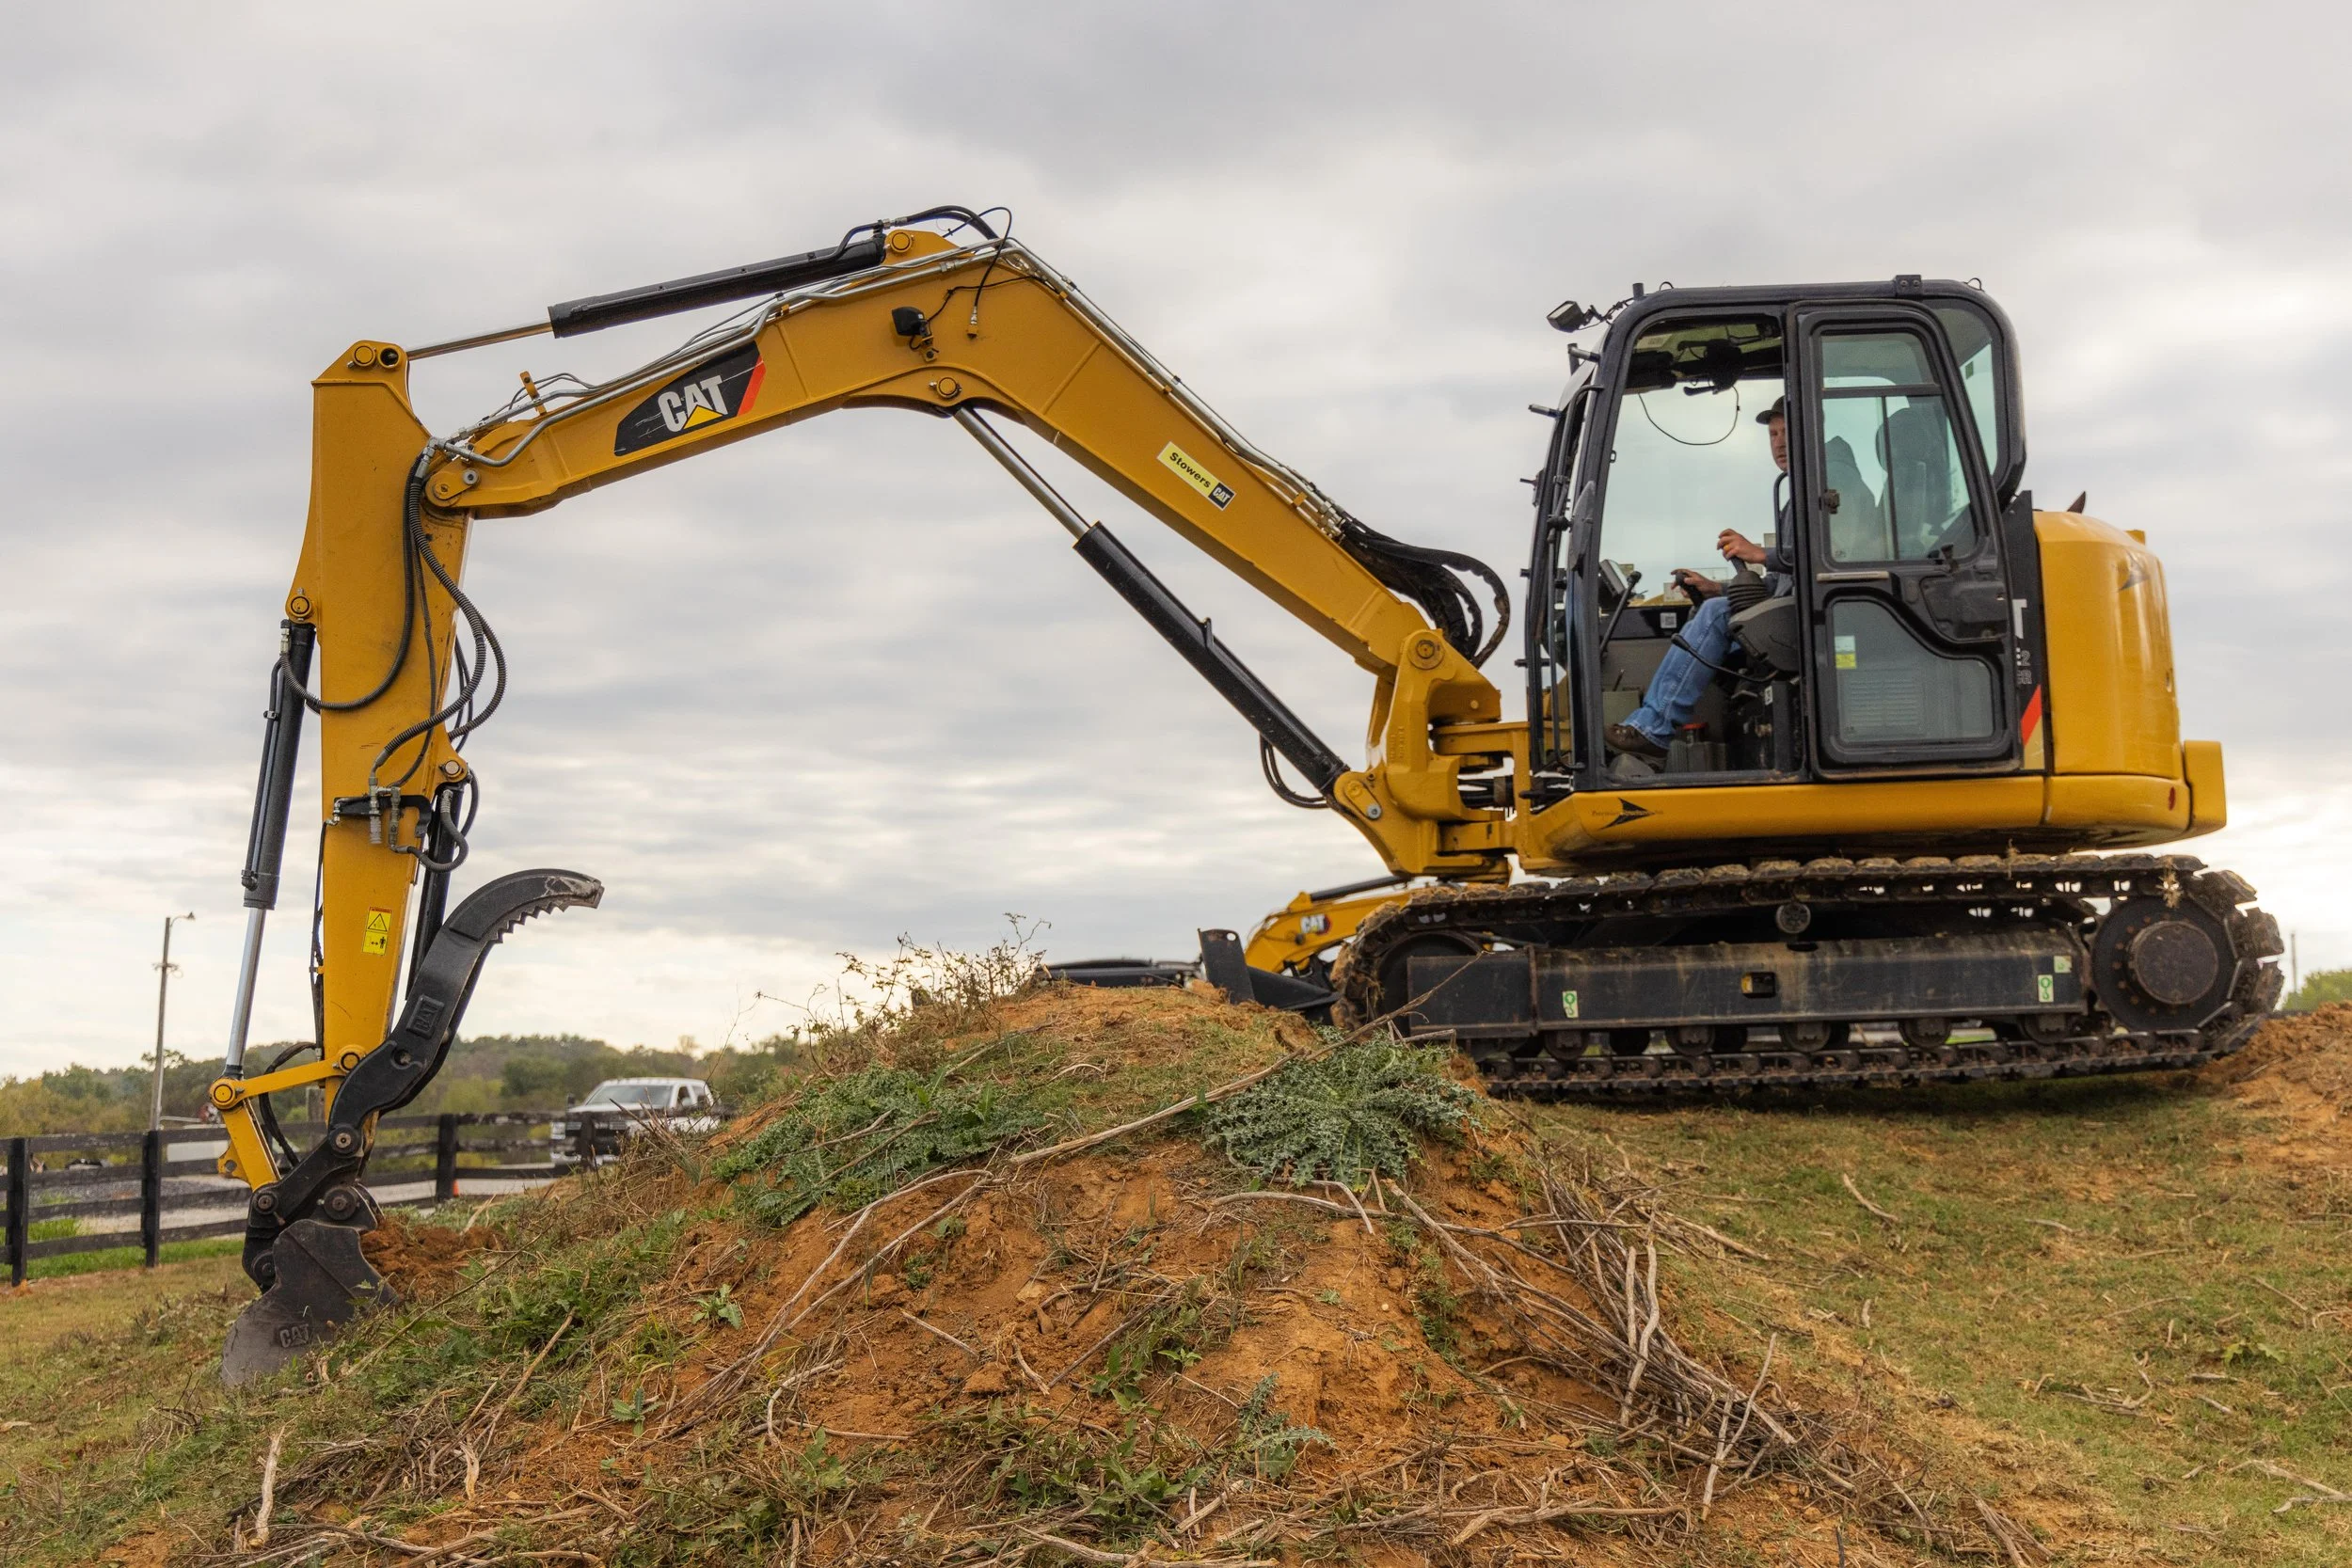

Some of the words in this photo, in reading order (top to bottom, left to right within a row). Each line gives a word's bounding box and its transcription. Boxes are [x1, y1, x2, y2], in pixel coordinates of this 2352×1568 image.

[658, 374, 729, 433] CAT
[1169, 451, 1211, 488] Stowers
[1212, 486, 1231, 503] CAT
[1300, 913, 1326, 934] CAT
[279, 1323, 309, 1348] CAT
